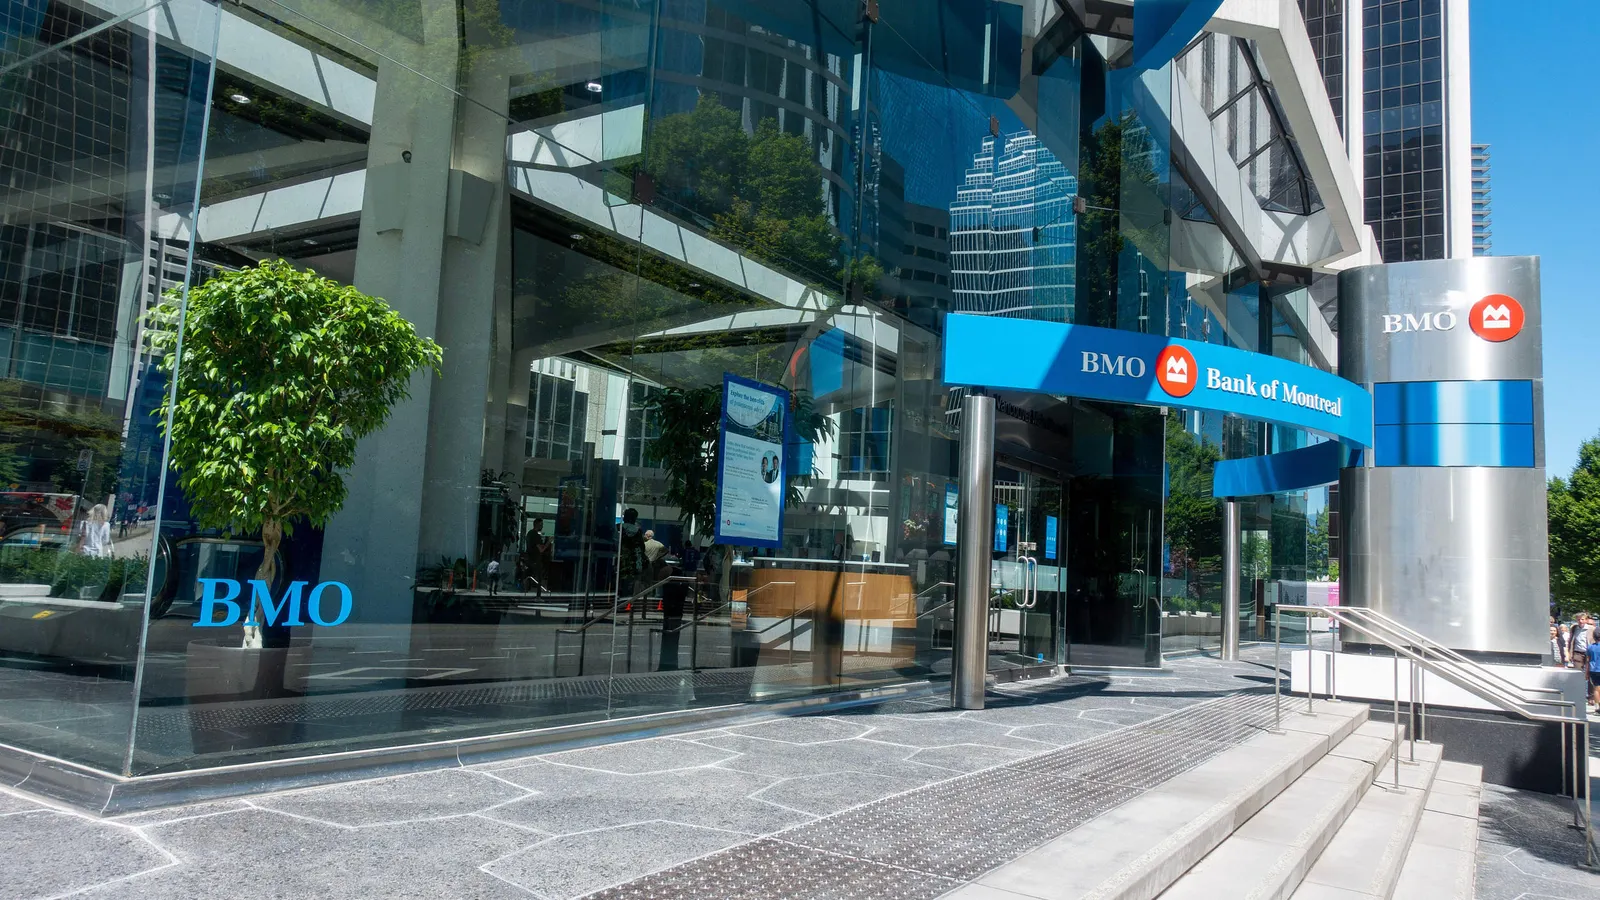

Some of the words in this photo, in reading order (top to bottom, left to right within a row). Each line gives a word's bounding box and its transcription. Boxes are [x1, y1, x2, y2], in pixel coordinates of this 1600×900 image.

[1382, 311, 1457, 334] BMO
[1081, 351, 1146, 378] BMO
[1206, 367, 1258, 396] Bank
[1260, 379, 1279, 400] of
[1282, 382, 1342, 417] Montreal
[192, 577, 353, 628] BMO
